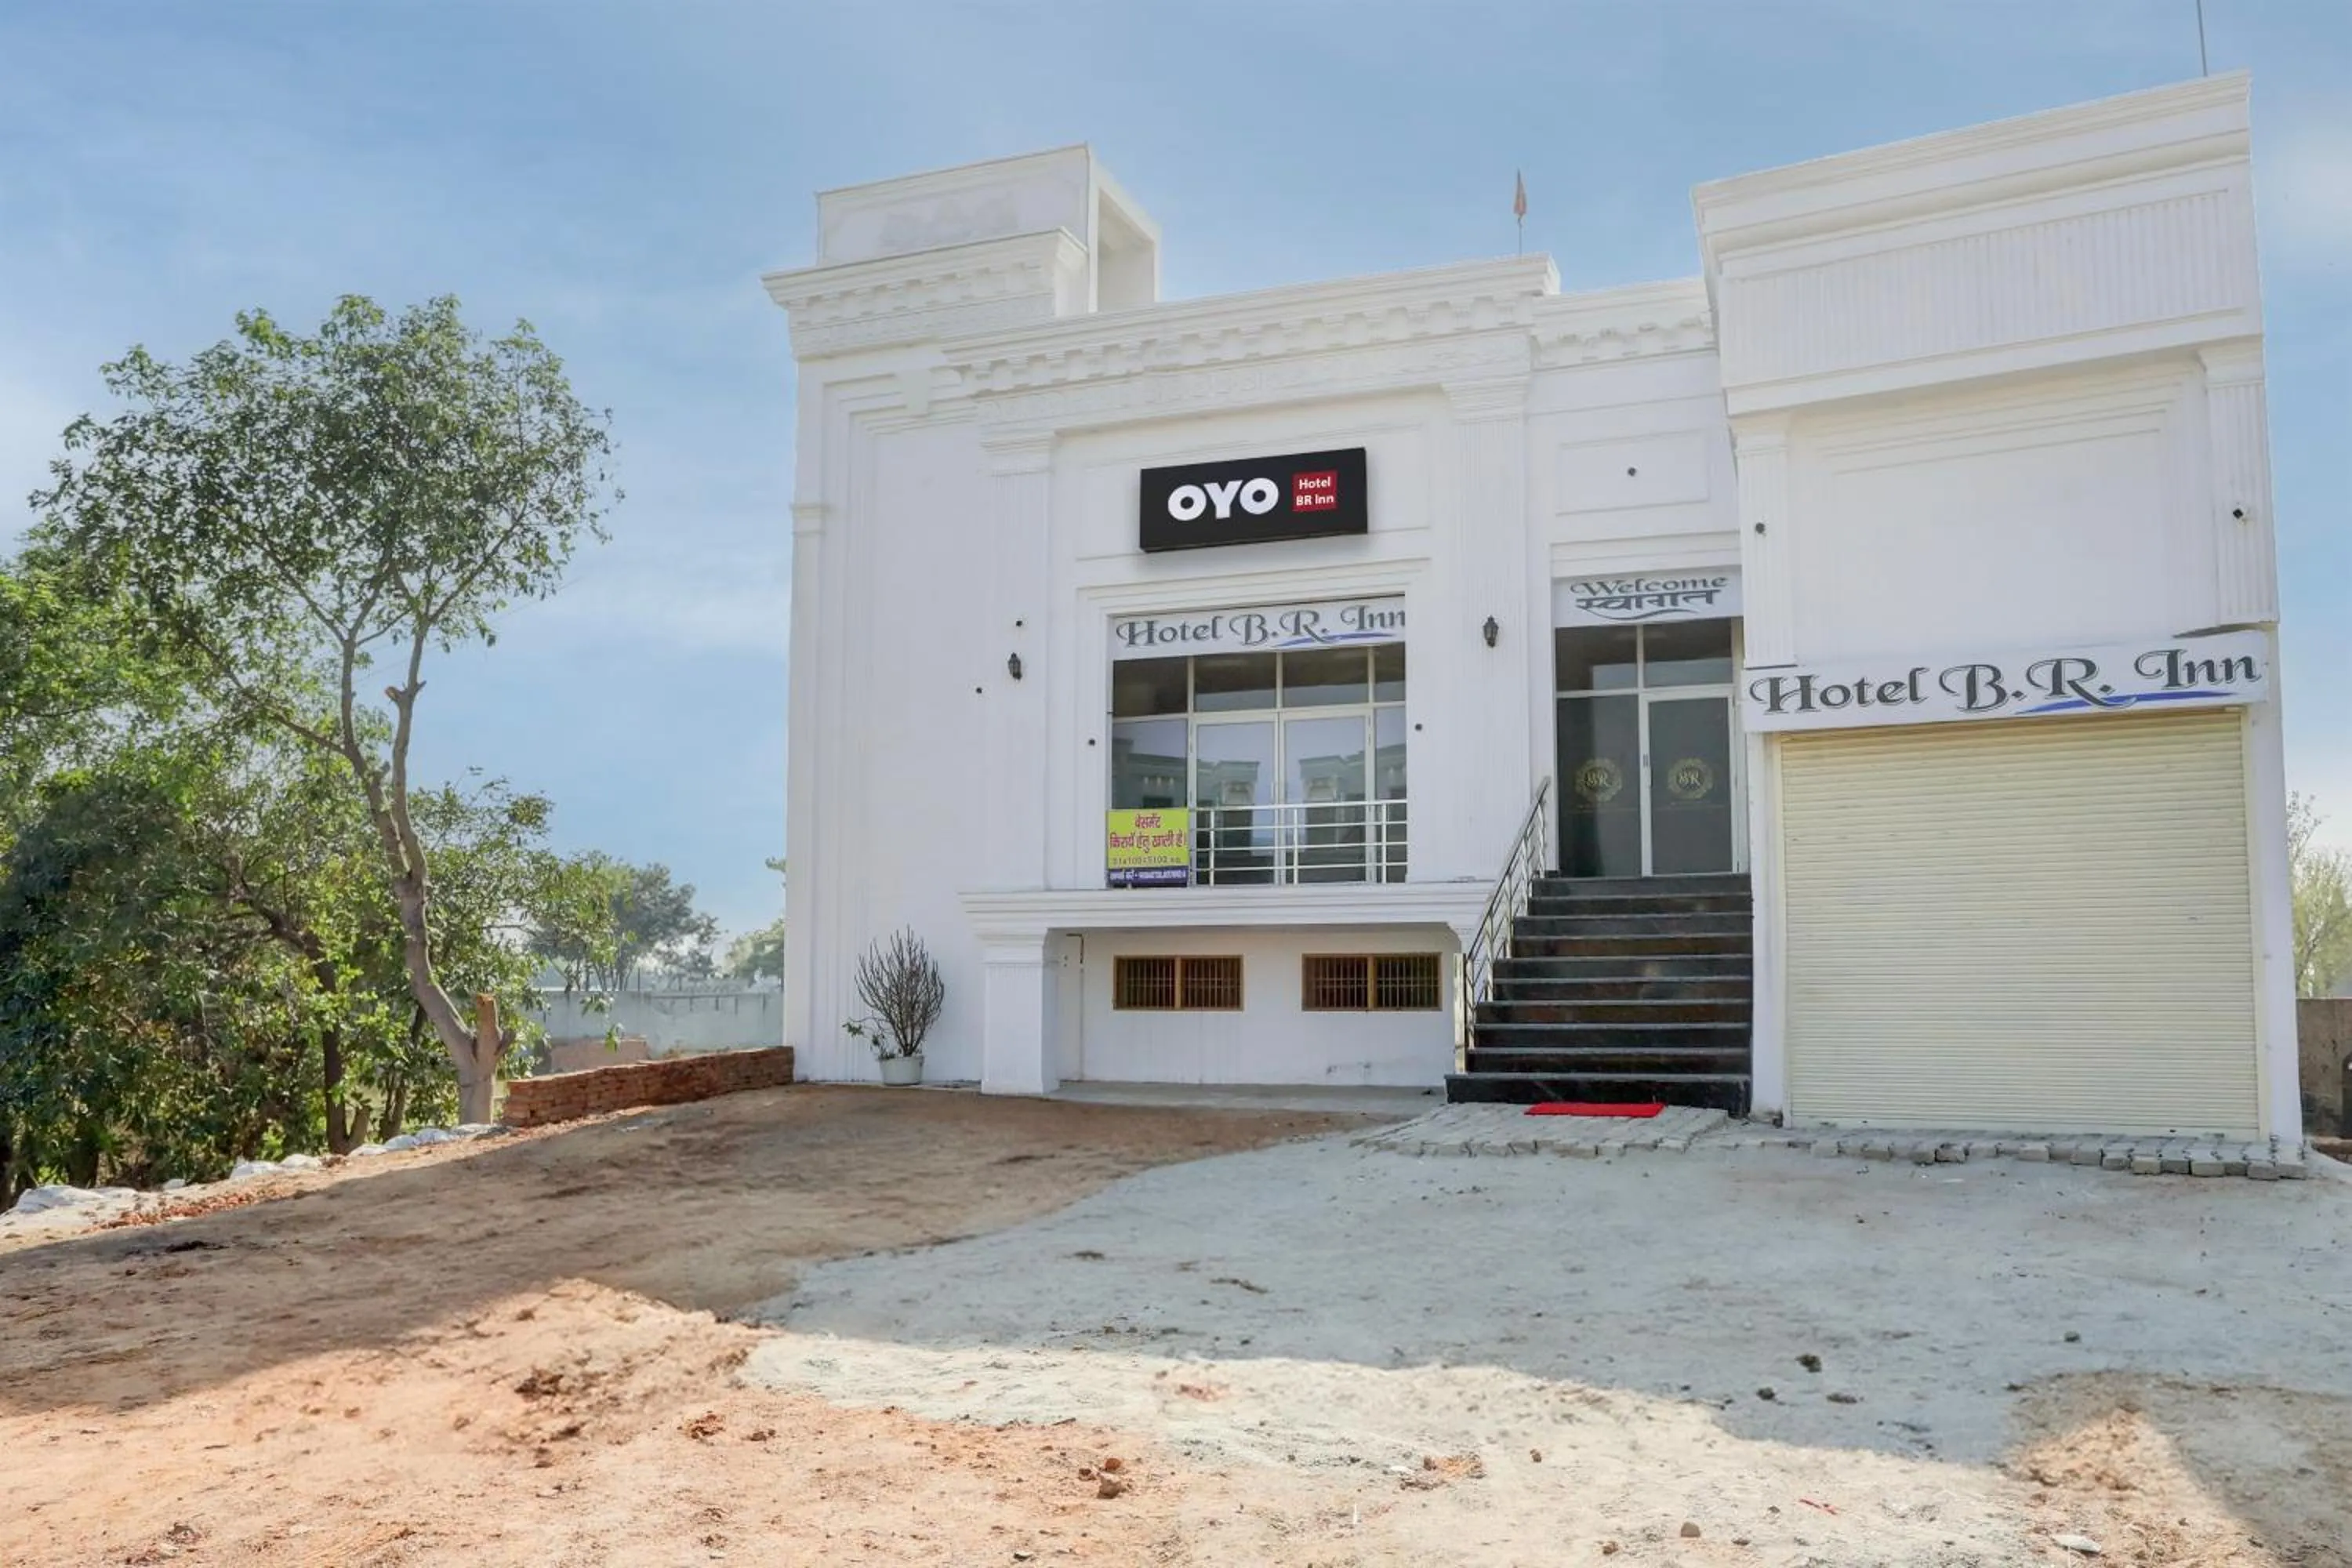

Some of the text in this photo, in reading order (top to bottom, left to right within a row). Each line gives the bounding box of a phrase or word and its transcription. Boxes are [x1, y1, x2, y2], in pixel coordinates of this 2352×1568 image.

[1298, 476, 1331, 490] Hotel
[1167, 477, 1279, 521] OYO
[1295, 494, 1335, 506] BR Inn
[1570, 577, 1729, 597] Welcome
[1575, 589, 1722, 612] स्वागत
[1116, 615, 1224, 647] Hotel
[1340, 604, 1405, 632] Inn
[1749, 666, 1930, 715] Hotel
[2133, 648, 2263, 691] Inn
